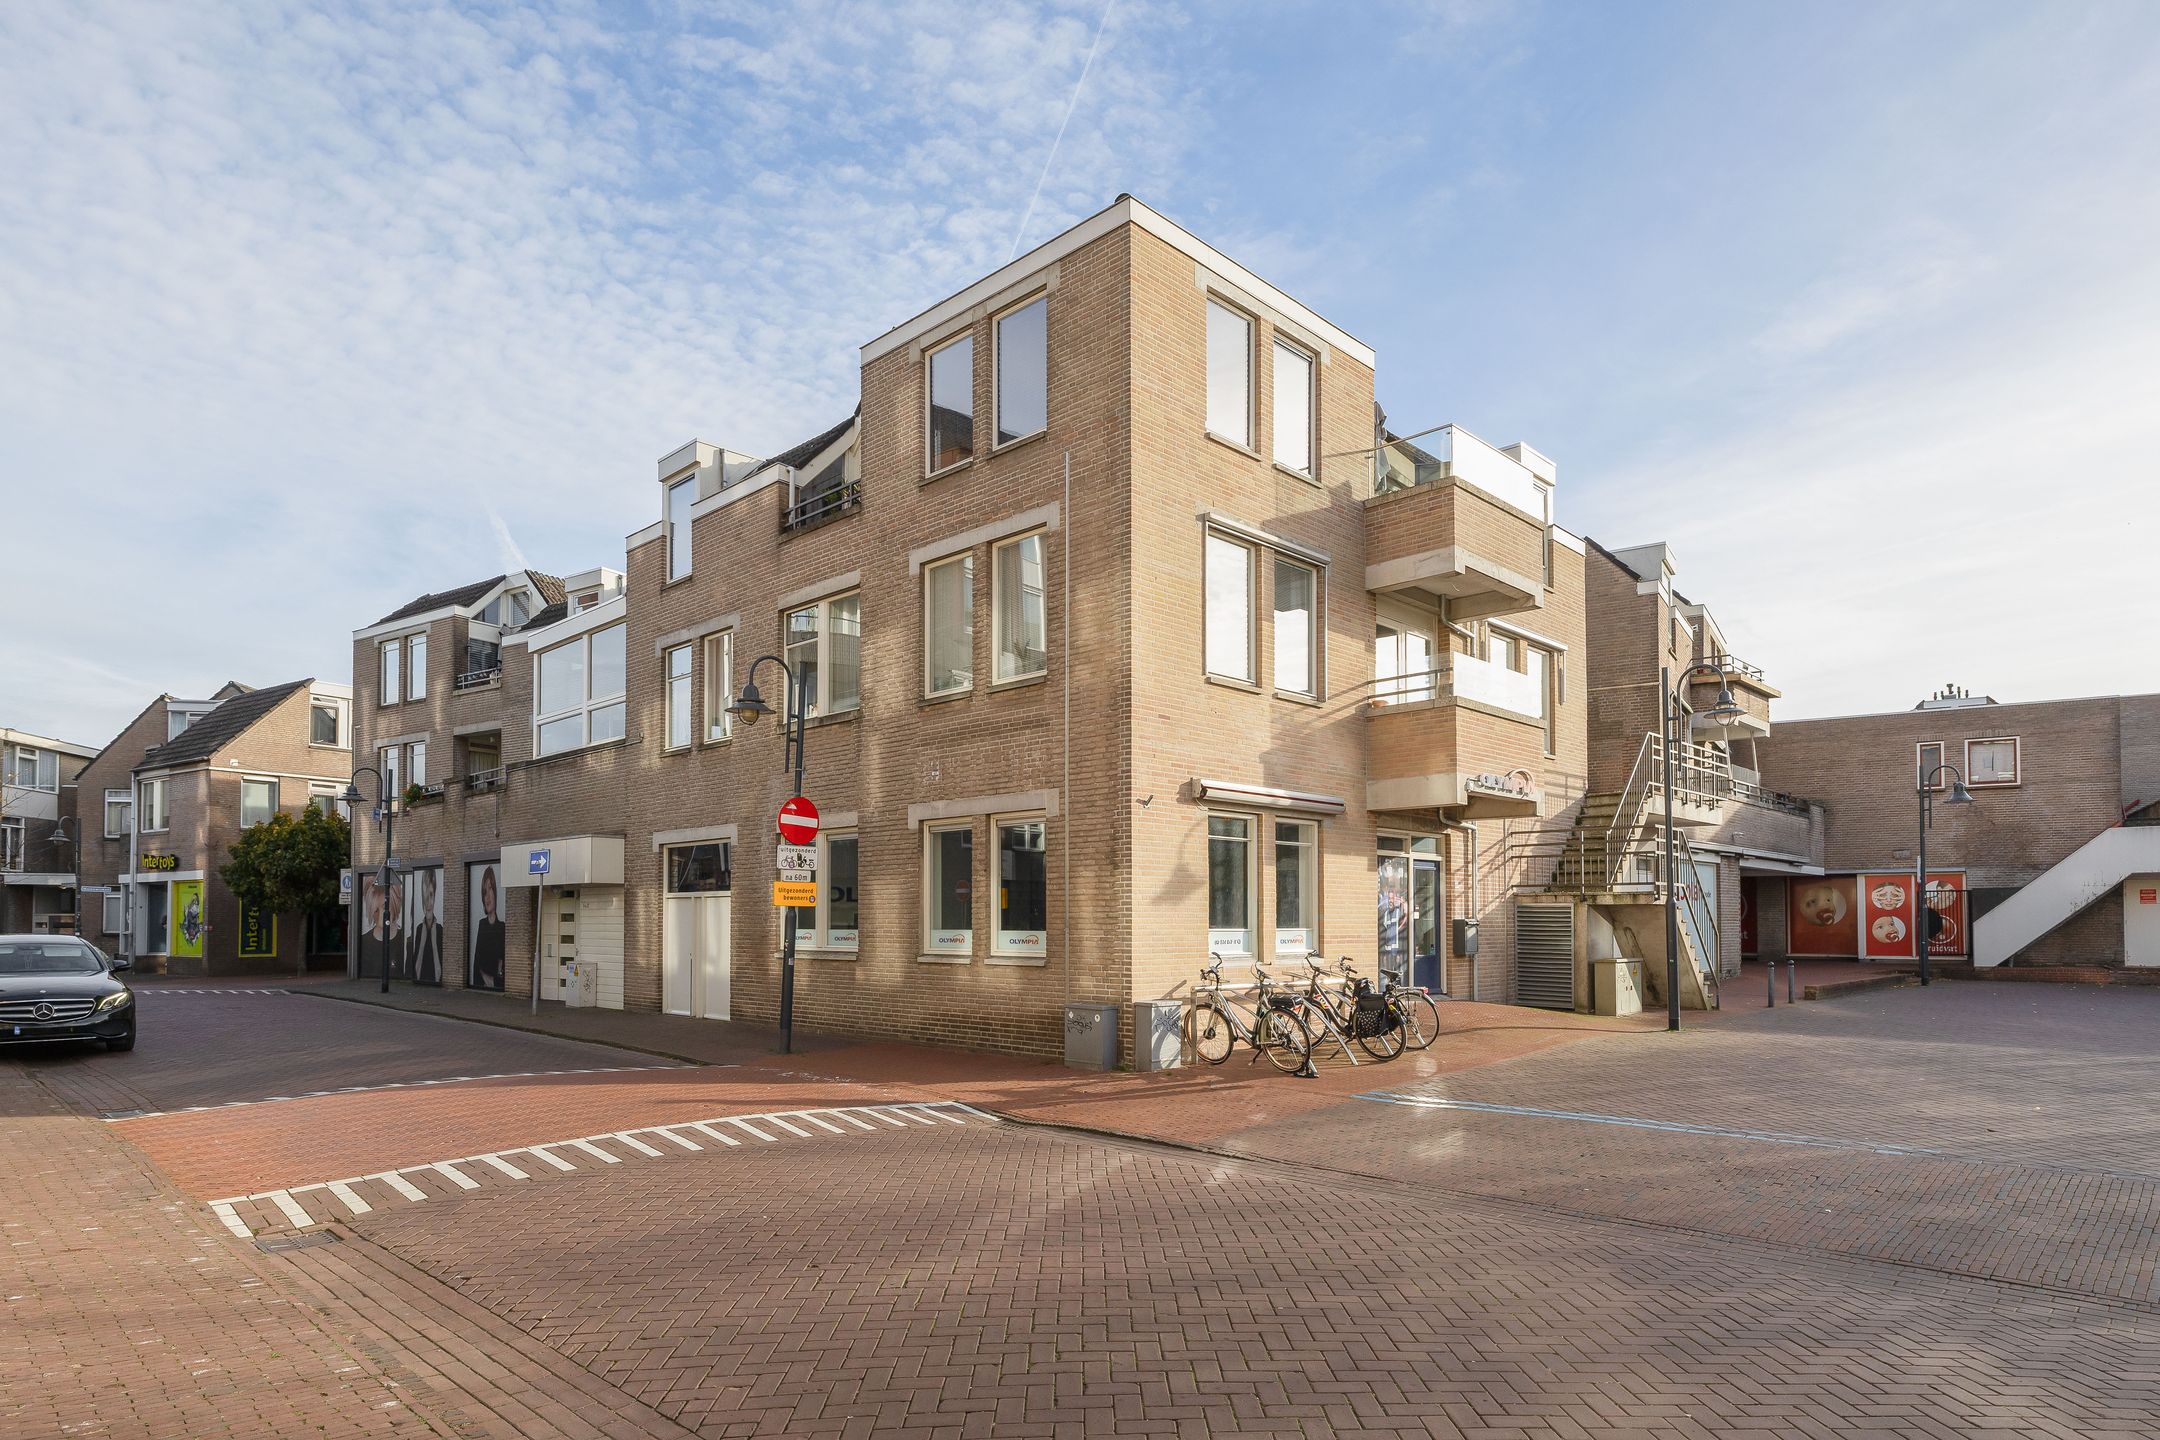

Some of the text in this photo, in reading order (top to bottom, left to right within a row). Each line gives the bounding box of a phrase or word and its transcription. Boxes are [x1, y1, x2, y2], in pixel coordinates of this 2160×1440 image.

[780, 846, 817, 854] uitgezonderd
[142, 853, 175, 871] Intertoys
[794, 873, 808, 882] 60m
[778, 887, 814, 895] Uitgezonderd
[938, 935, 965, 944] OLYMPIA
[1009, 937, 1039, 946] OLYMPIA
[1279, 936, 1304, 945] OLYMPIA
[1927, 944, 1958, 953] ruidvat
